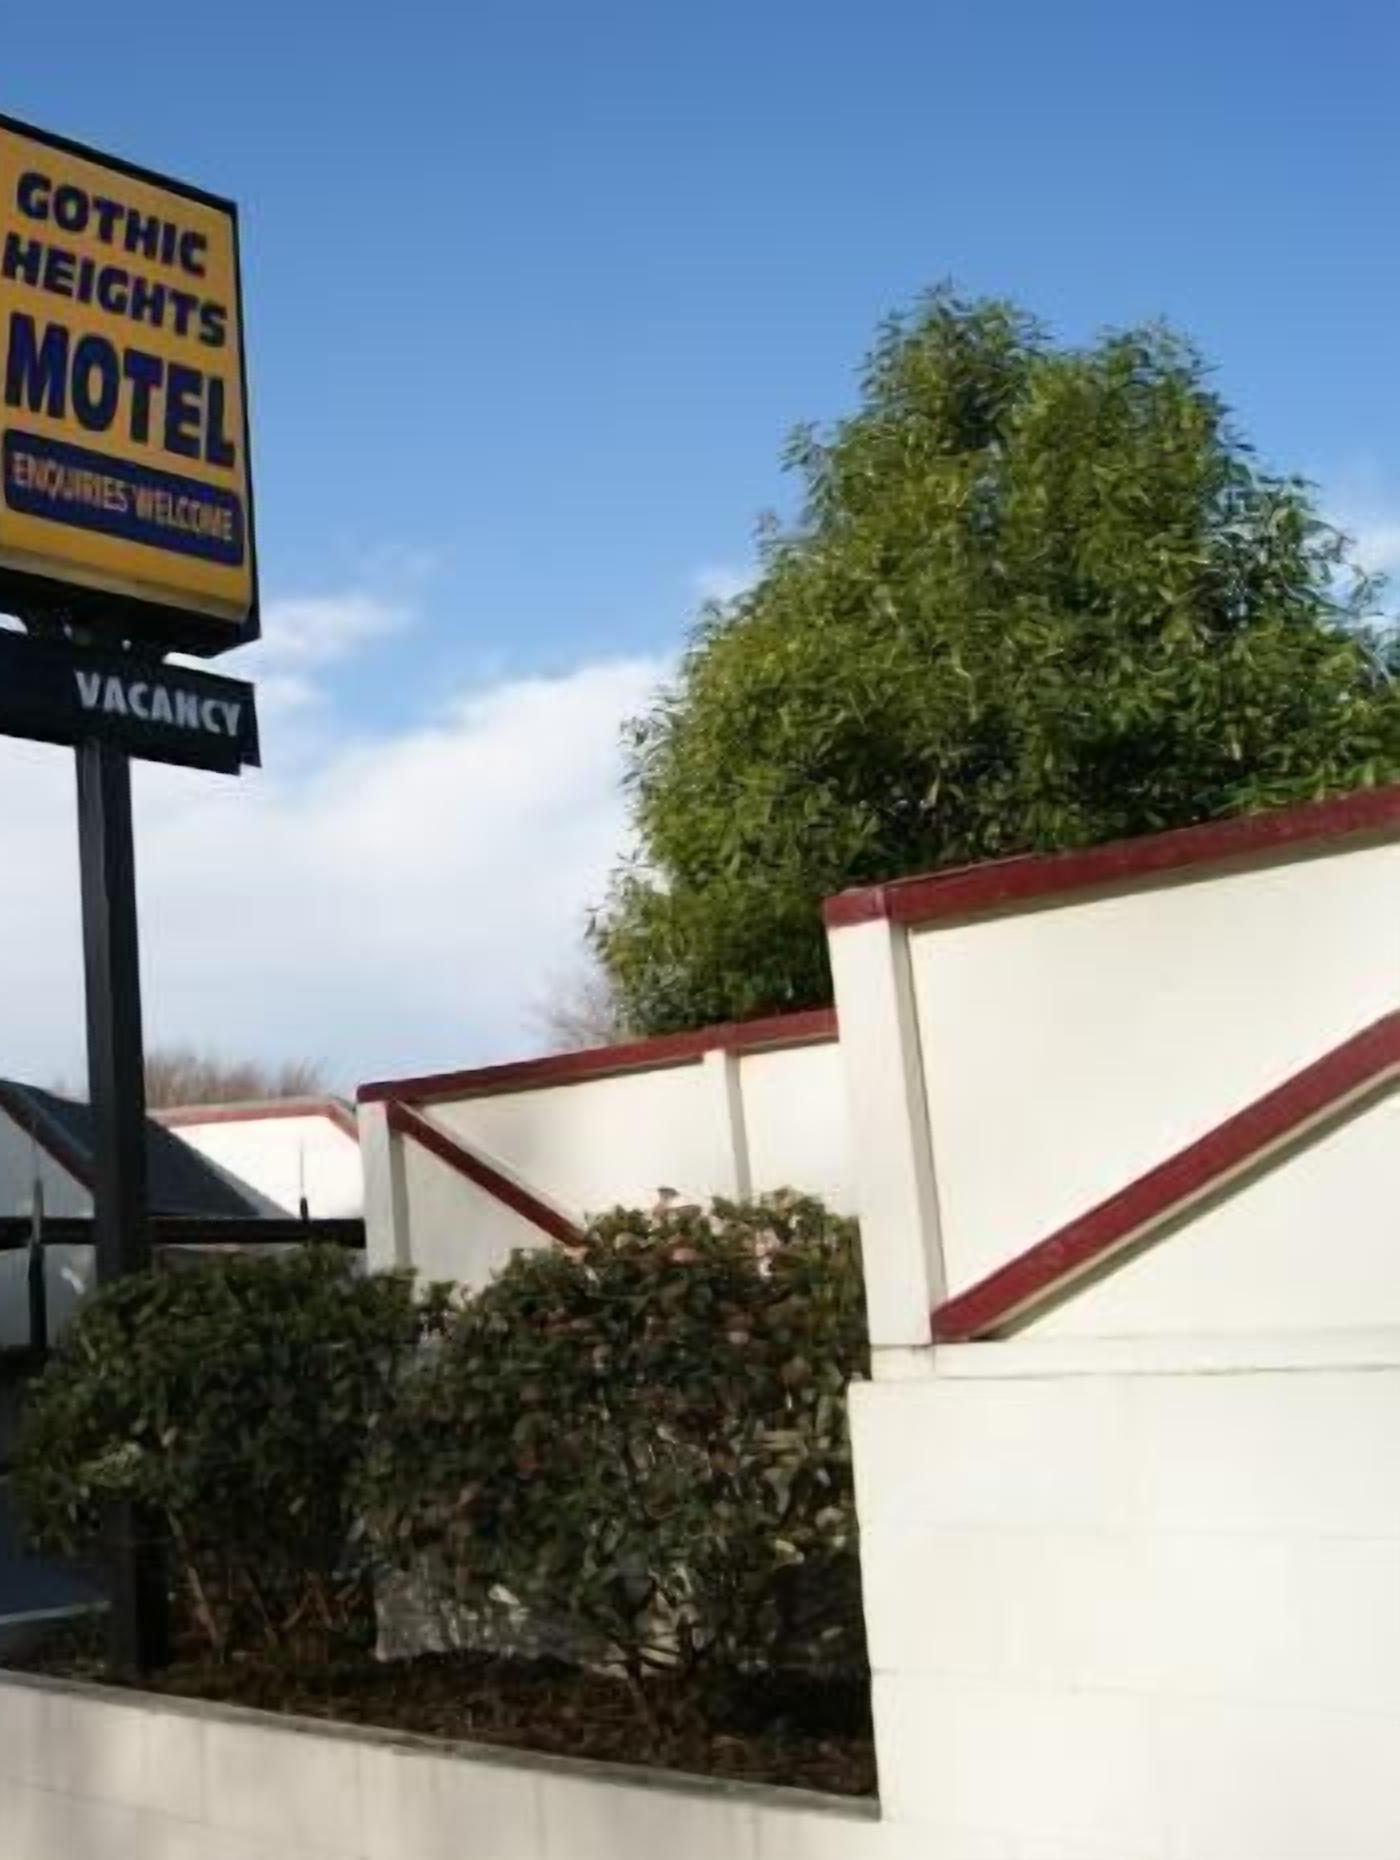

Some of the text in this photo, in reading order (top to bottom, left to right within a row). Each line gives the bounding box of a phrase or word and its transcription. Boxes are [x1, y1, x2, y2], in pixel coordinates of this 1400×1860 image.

[16, 172, 207, 278] GOTHIC
[2, 232, 227, 348] HEIGHTS
[5, 312, 236, 468] MOTEL
[12, 452, 234, 542] ENQUIRIES WELCOME
[74, 670, 242, 737] VACANCY
